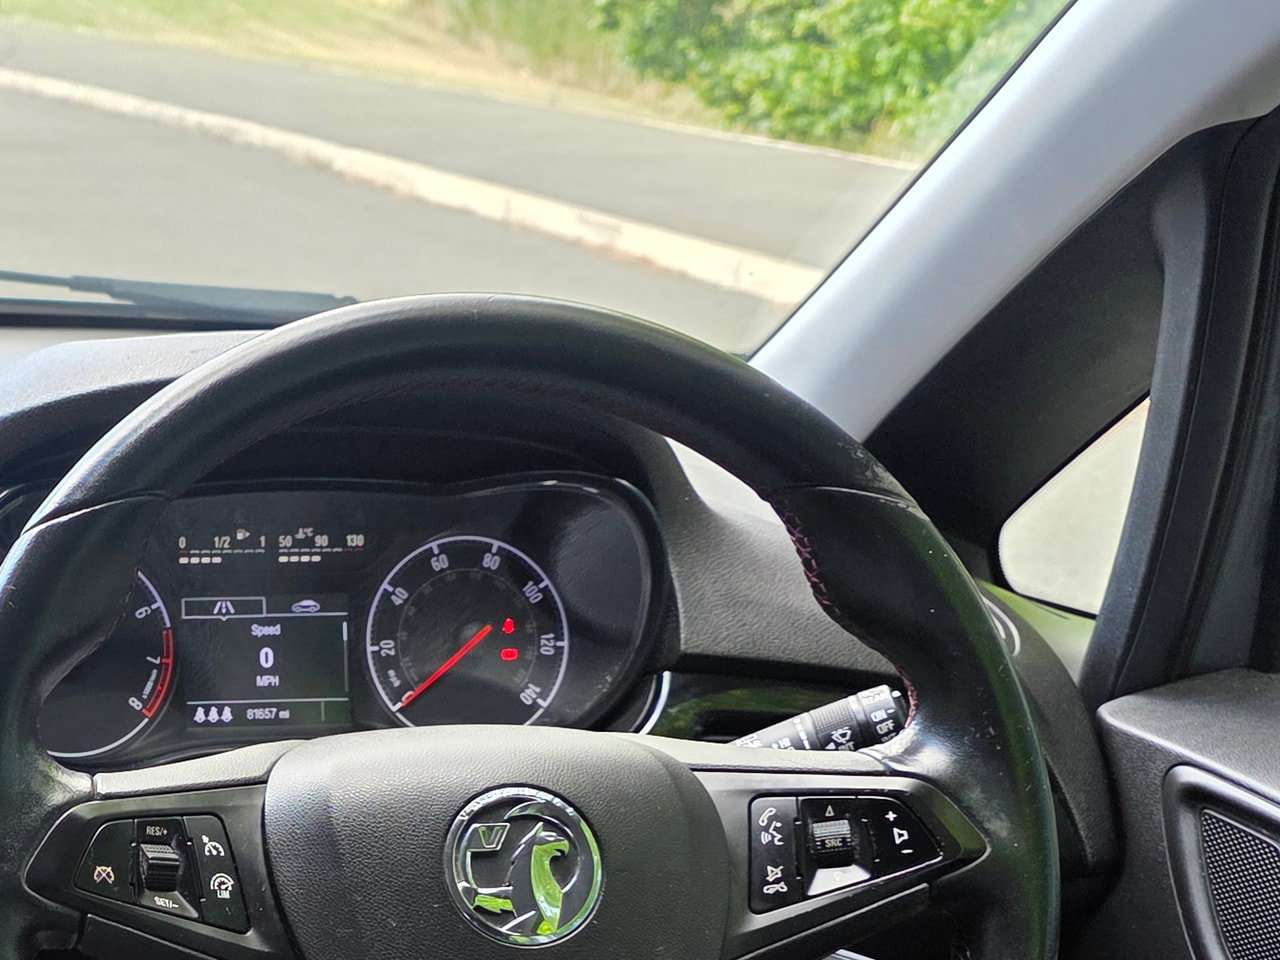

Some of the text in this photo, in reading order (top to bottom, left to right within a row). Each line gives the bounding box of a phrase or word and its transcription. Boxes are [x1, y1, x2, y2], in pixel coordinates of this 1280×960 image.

[178, 536, 186, 549] 0
[213, 536, 232, 548] 1/2
[278, 534, 365, 547] 50 90 130
[430, 553, 449, 571] 60
[482, 553, 501, 570] 80
[390, 587, 409, 606] 40
[522, 580, 544, 604] 100
[134, 606, 151, 619] 6
[250, 623, 281, 637] Speed
[379, 639, 396, 657] 20
[539, 632, 555, 656] 120
[146, 655, 161, 665] 7
[259, 646, 275, 669] 0
[255, 675, 280, 687] MPH
[519, 682, 541, 706] 140
[127, 696, 143, 711] 8
[875, 719, 897, 735] OFF
[824, 837, 843, 849] SRC
